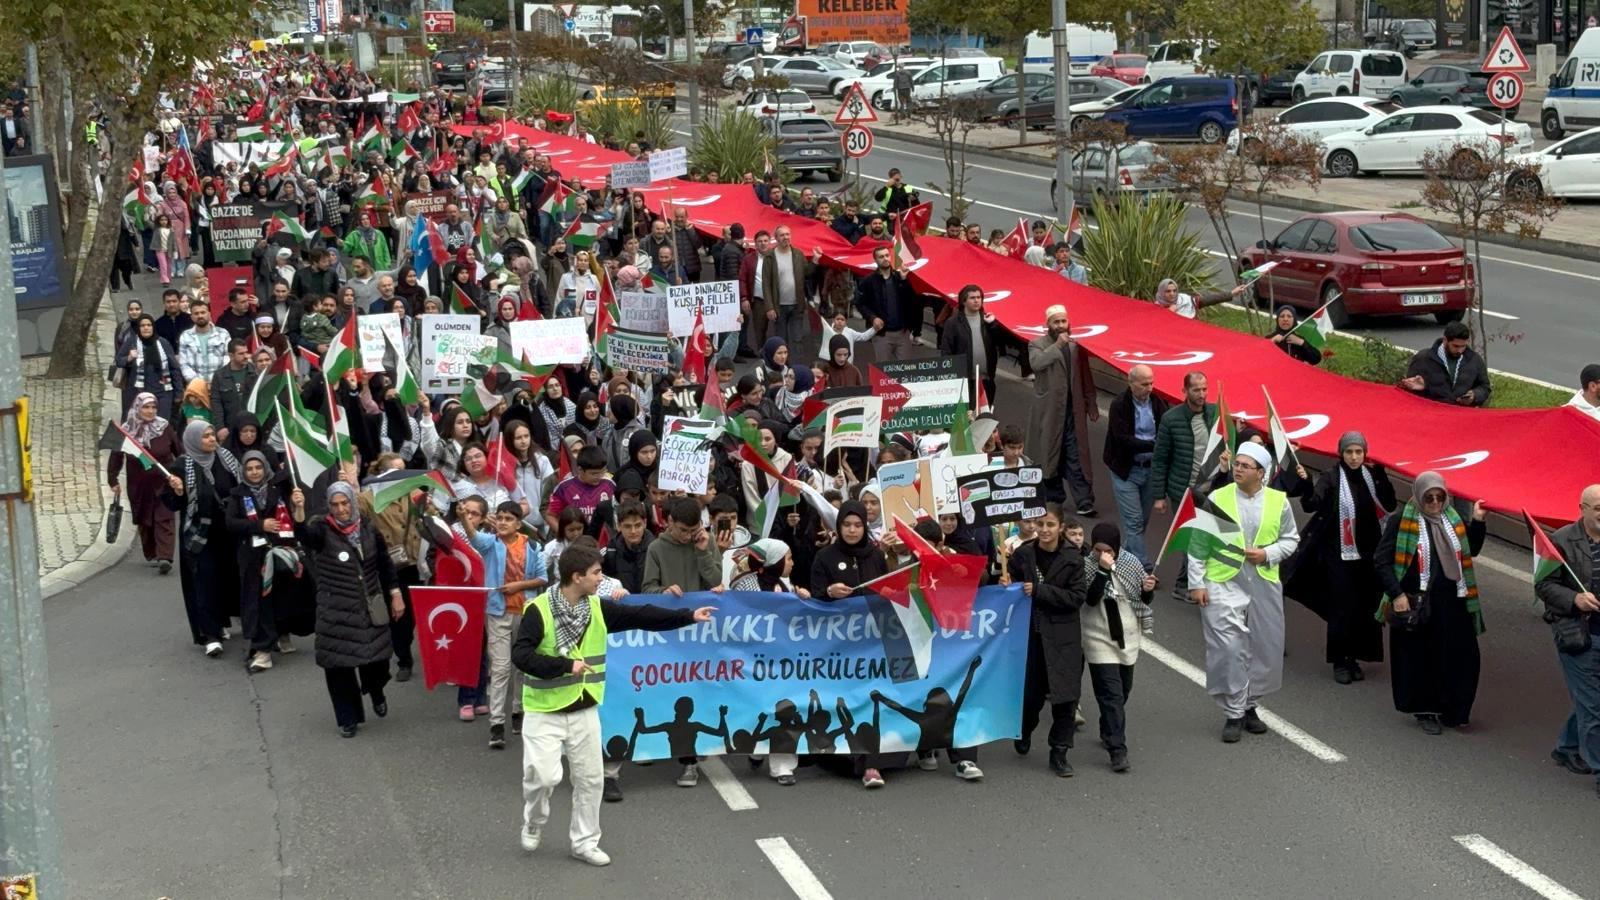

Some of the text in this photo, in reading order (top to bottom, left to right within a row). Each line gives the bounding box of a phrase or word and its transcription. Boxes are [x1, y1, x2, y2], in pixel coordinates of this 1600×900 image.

[1495, 79, 1516, 99] 30
[848, 131, 866, 150] 30
[211, 205, 254, 218] GAZZE'DE
[434, 323, 471, 331] ÖLÜMDEN
[678, 612, 779, 645] HAKKI
[631, 651, 929, 692] ÇOCUKLAR ÖLDÜRÜLEMEZ
